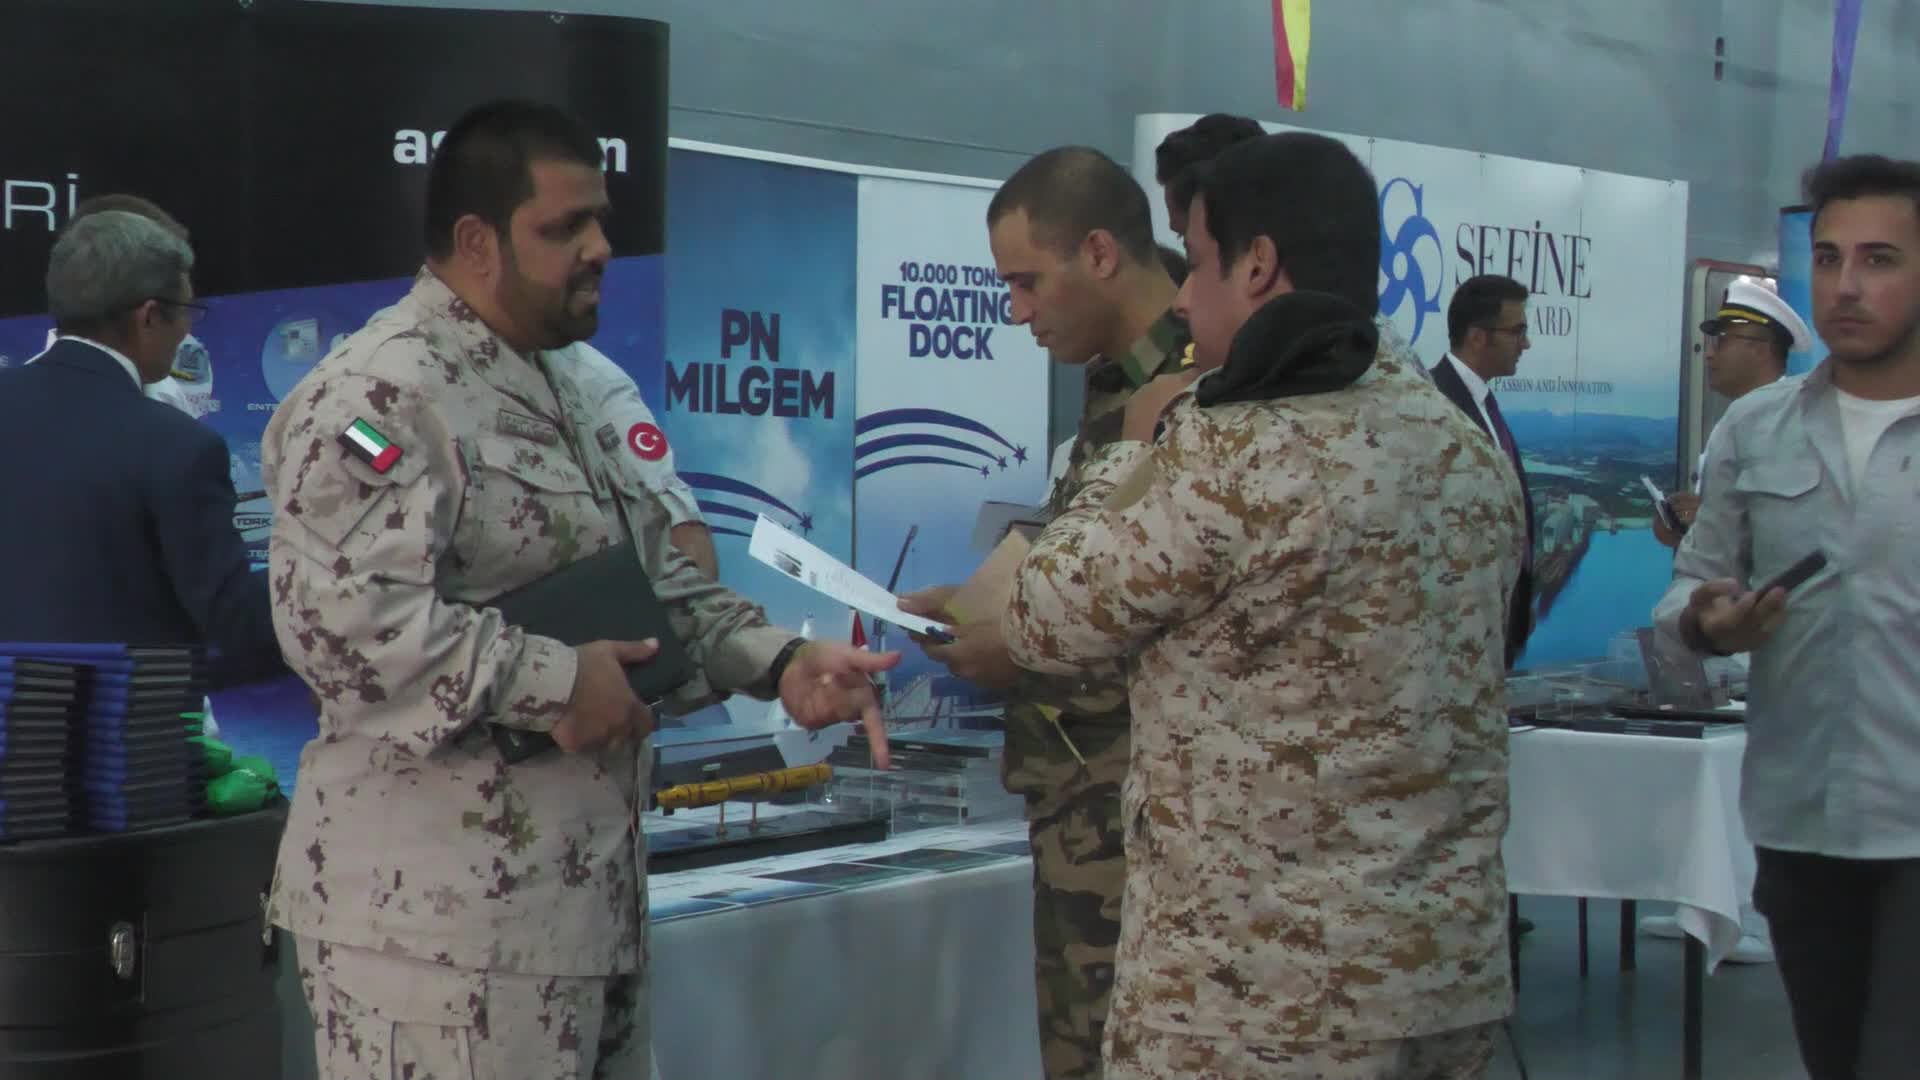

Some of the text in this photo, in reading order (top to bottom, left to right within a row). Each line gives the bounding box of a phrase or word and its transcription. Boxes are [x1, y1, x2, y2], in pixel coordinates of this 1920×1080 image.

[899, 261, 958, 285] 10.000
[720, 308, 781, 362] PN
[909, 323, 994, 361] DOCK
[665, 360, 836, 420] MILGEM
